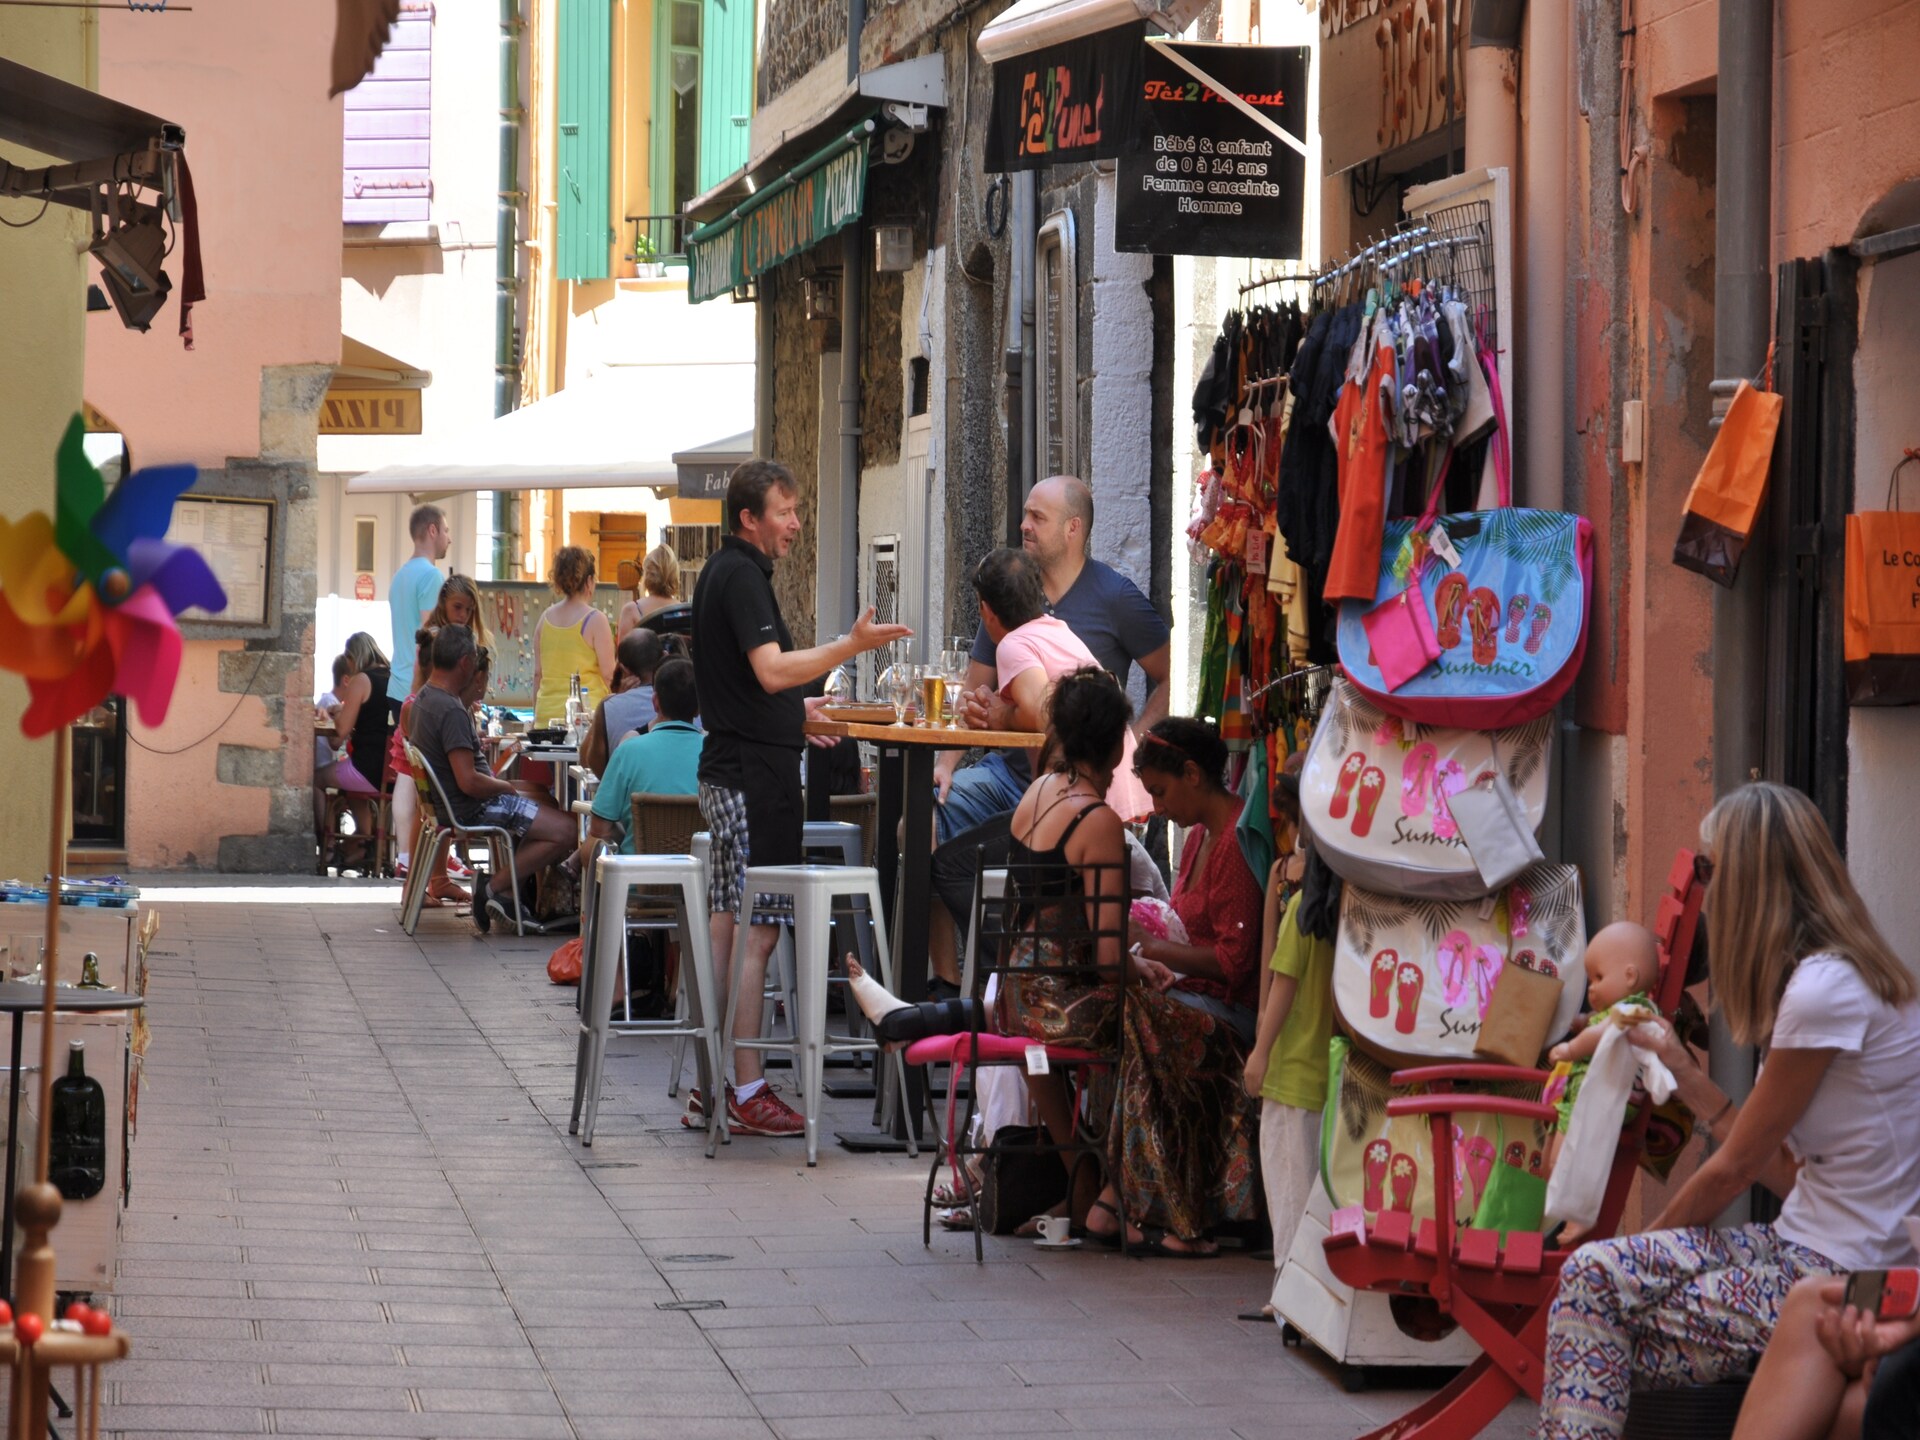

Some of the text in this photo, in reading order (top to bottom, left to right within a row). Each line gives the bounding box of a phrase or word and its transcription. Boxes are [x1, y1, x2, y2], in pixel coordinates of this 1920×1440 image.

[1154, 135, 1273, 157] Bébé & enfant
[1156, 155, 1268, 177] de 0 à 14 ans
[1143, 175, 1280, 197] Femme enceinte
[1178, 197, 1243, 215] Homme
[704, 470, 731, 491] Fab
[1883, 549, 1899, 567] Le
[1391, 815, 1468, 849] Summ
